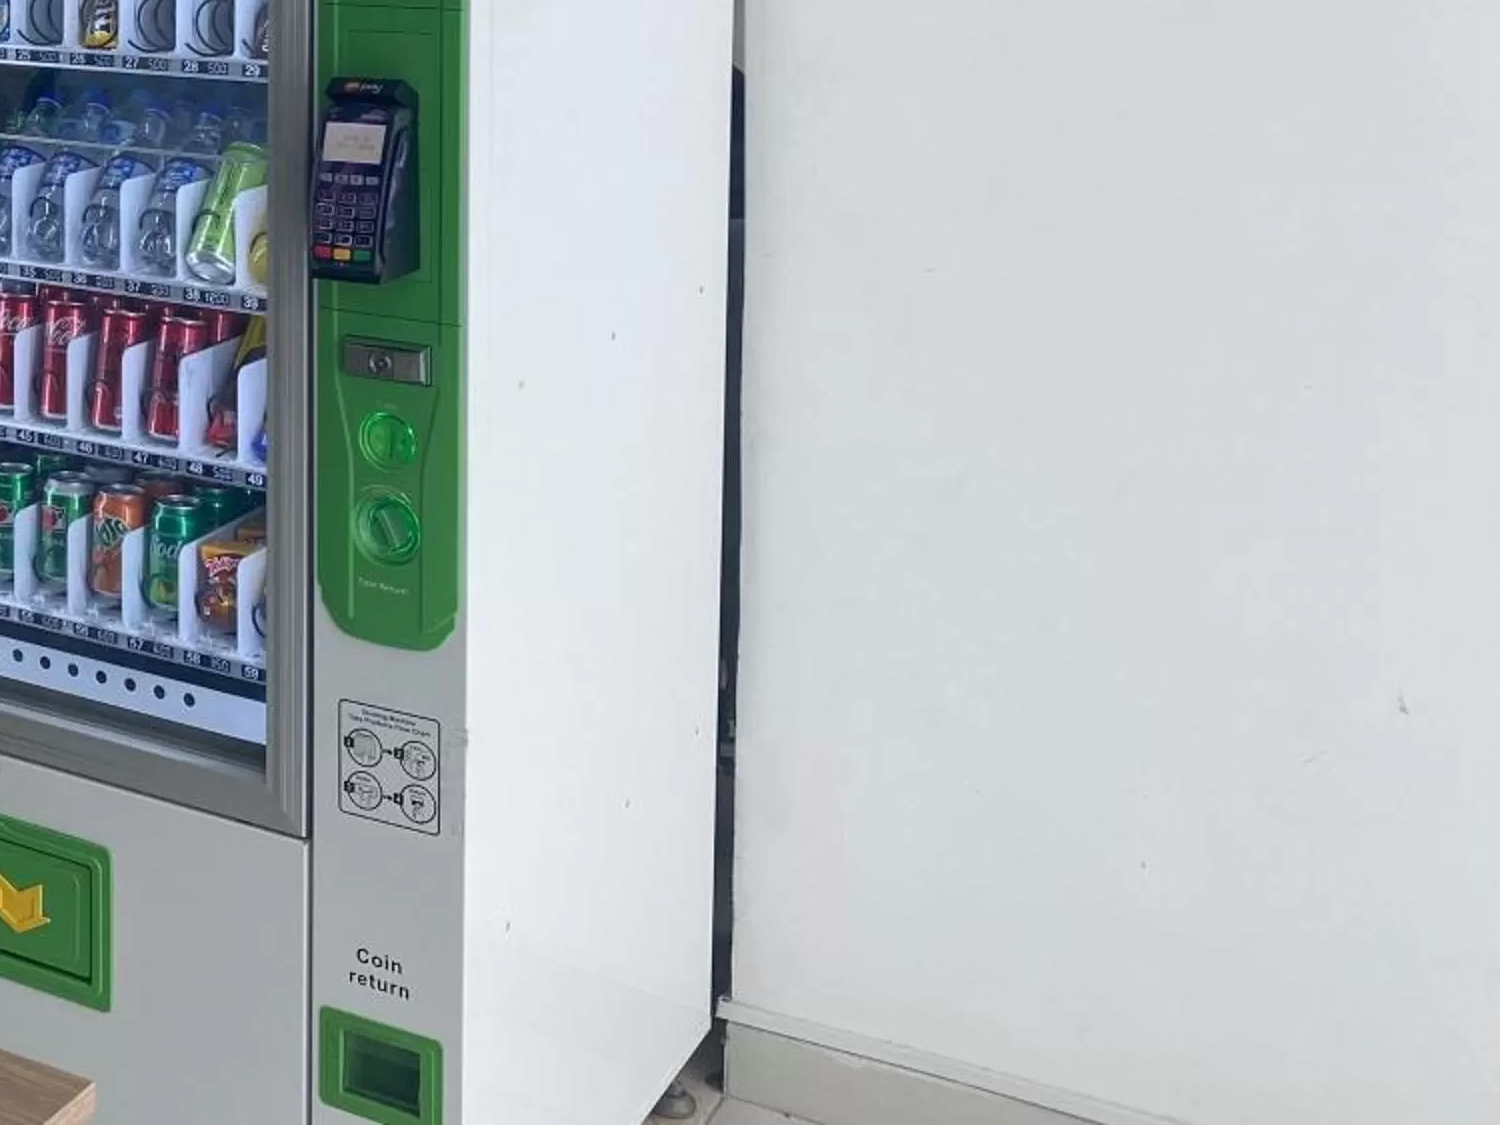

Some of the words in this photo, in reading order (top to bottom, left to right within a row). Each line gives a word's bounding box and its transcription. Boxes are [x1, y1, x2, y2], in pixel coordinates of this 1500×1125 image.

[134, 451, 149, 464] 47
[247, 473, 263, 486] 49
[356, 948, 403, 975] Coin
[349, 971, 410, 1001] return
